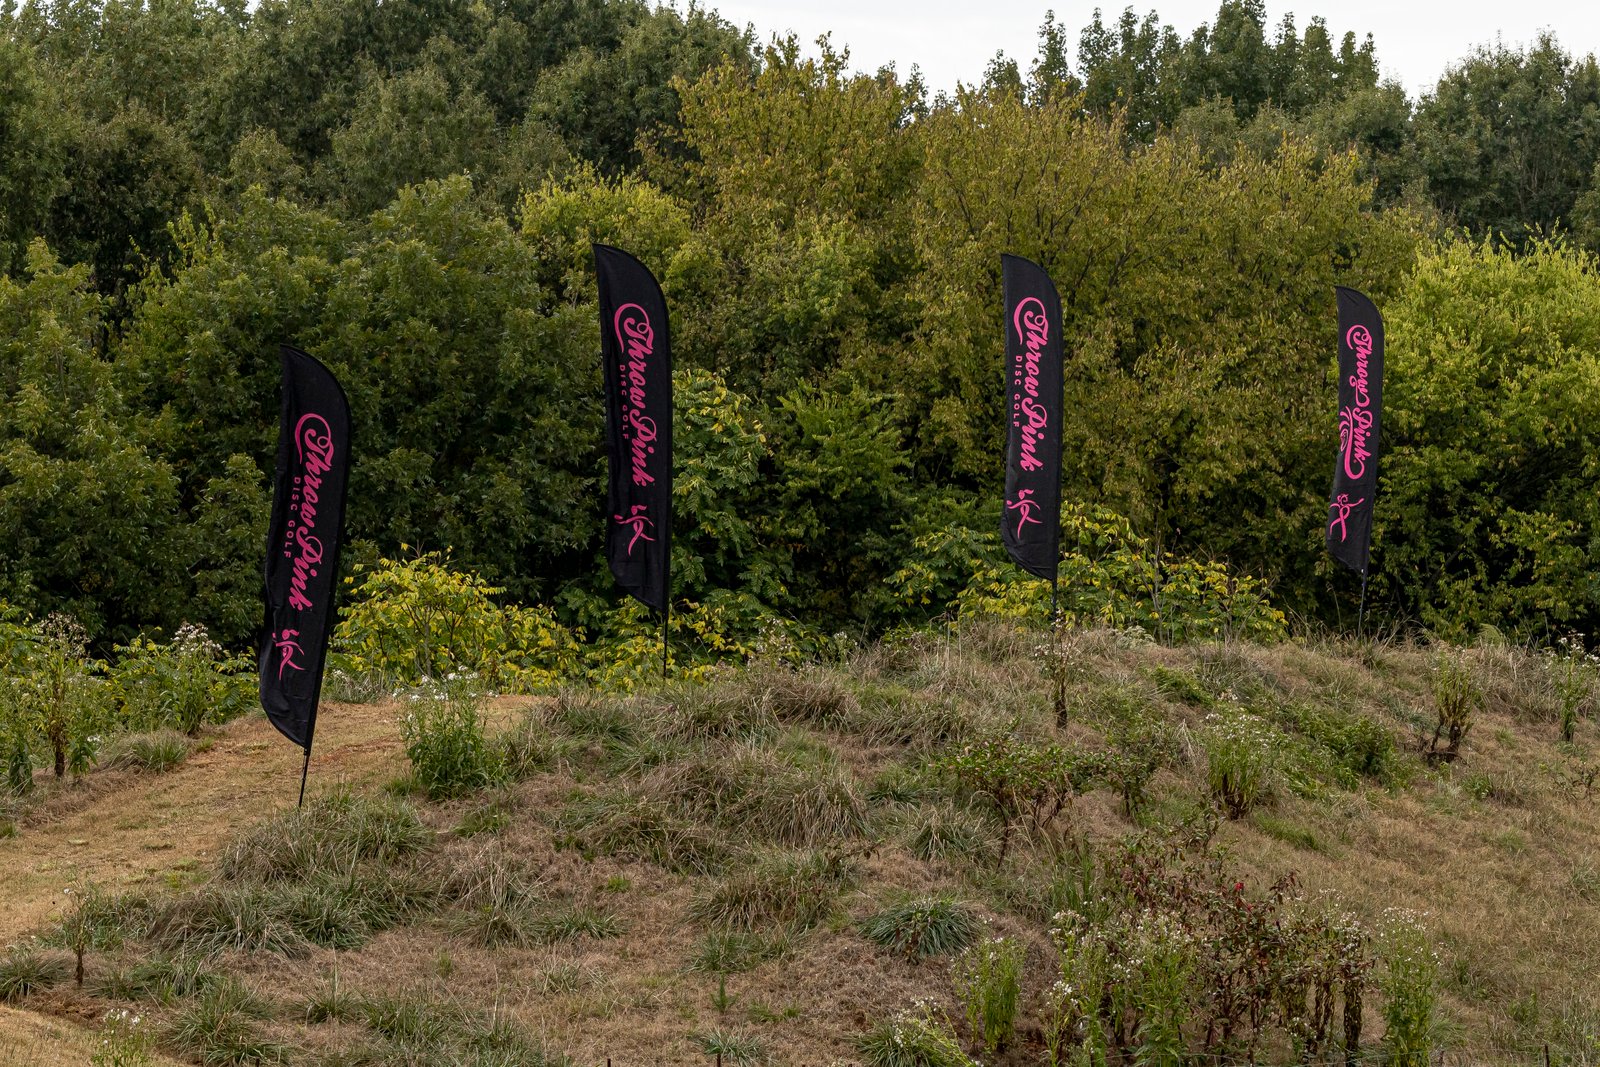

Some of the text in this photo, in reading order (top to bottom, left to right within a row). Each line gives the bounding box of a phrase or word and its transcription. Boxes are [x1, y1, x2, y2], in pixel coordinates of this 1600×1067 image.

[614, 303, 657, 487] Throw Pink
[619, 364, 628, 397] DISC
[1013, 296, 1049, 472] Throw Pink
[1013, 355, 1023, 428] DISC GOLF
[1346, 324, 1373, 480] Throw Pink
[284, 476, 301, 559] DISC GOLF
[288, 412, 335, 611] Throw Pink
